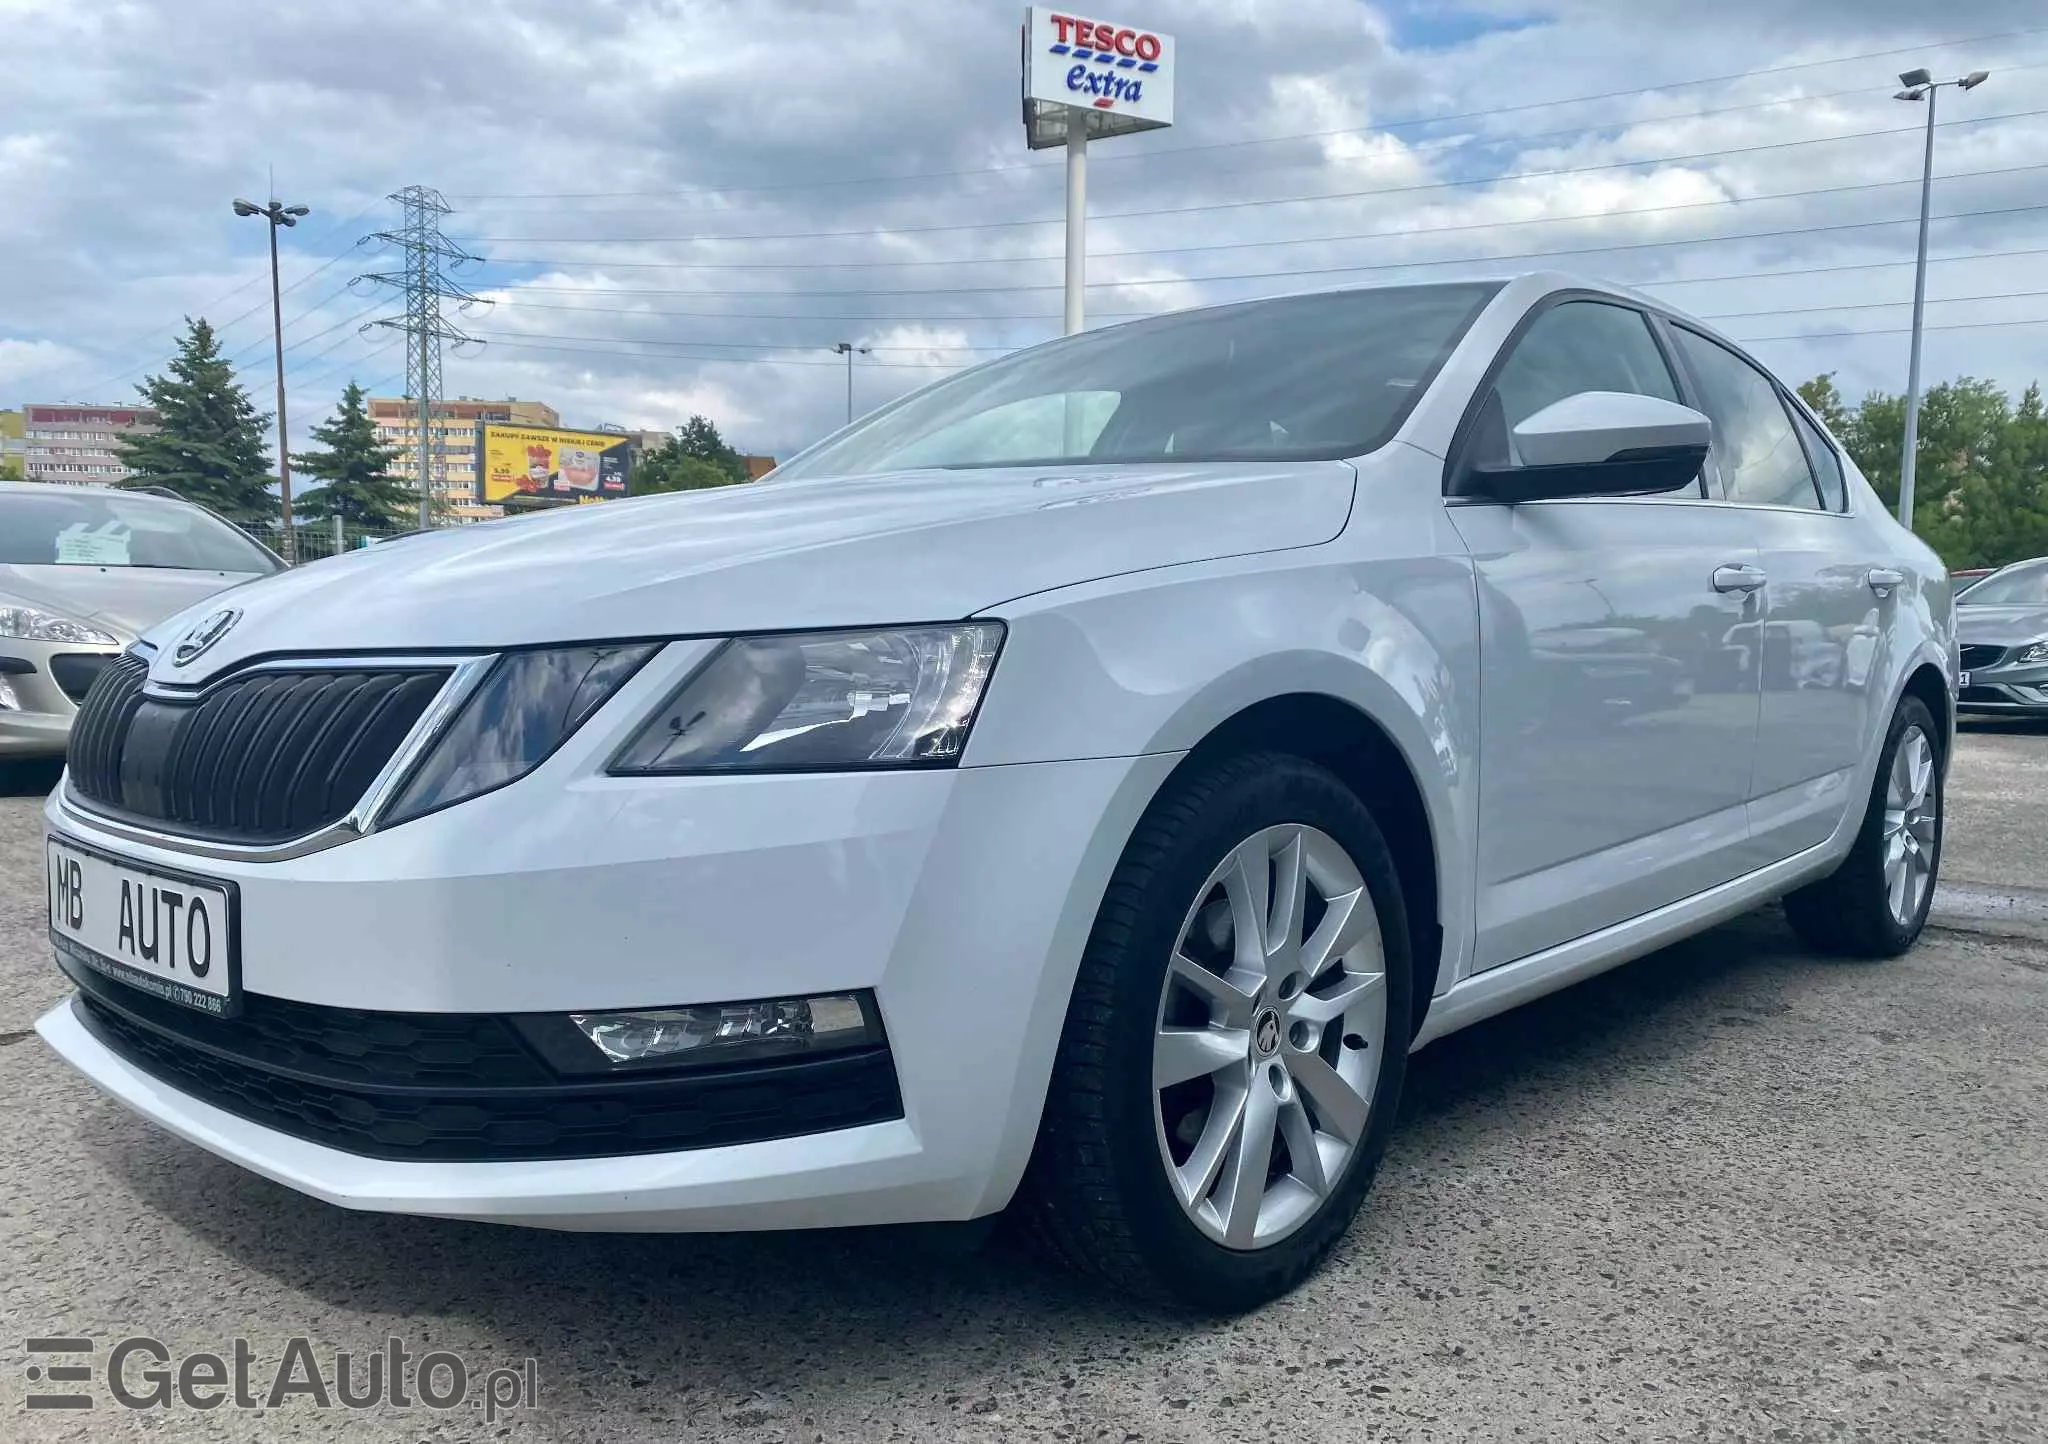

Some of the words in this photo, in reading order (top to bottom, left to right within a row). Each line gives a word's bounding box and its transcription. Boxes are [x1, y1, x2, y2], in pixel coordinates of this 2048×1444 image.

[1050, 13, 1161, 61] TESCO
[1067, 64, 1143, 102] extra
[56, 853, 83, 930] MB
[118, 879, 211, 978] AUTO
[193, 991, 206, 1009] 222
